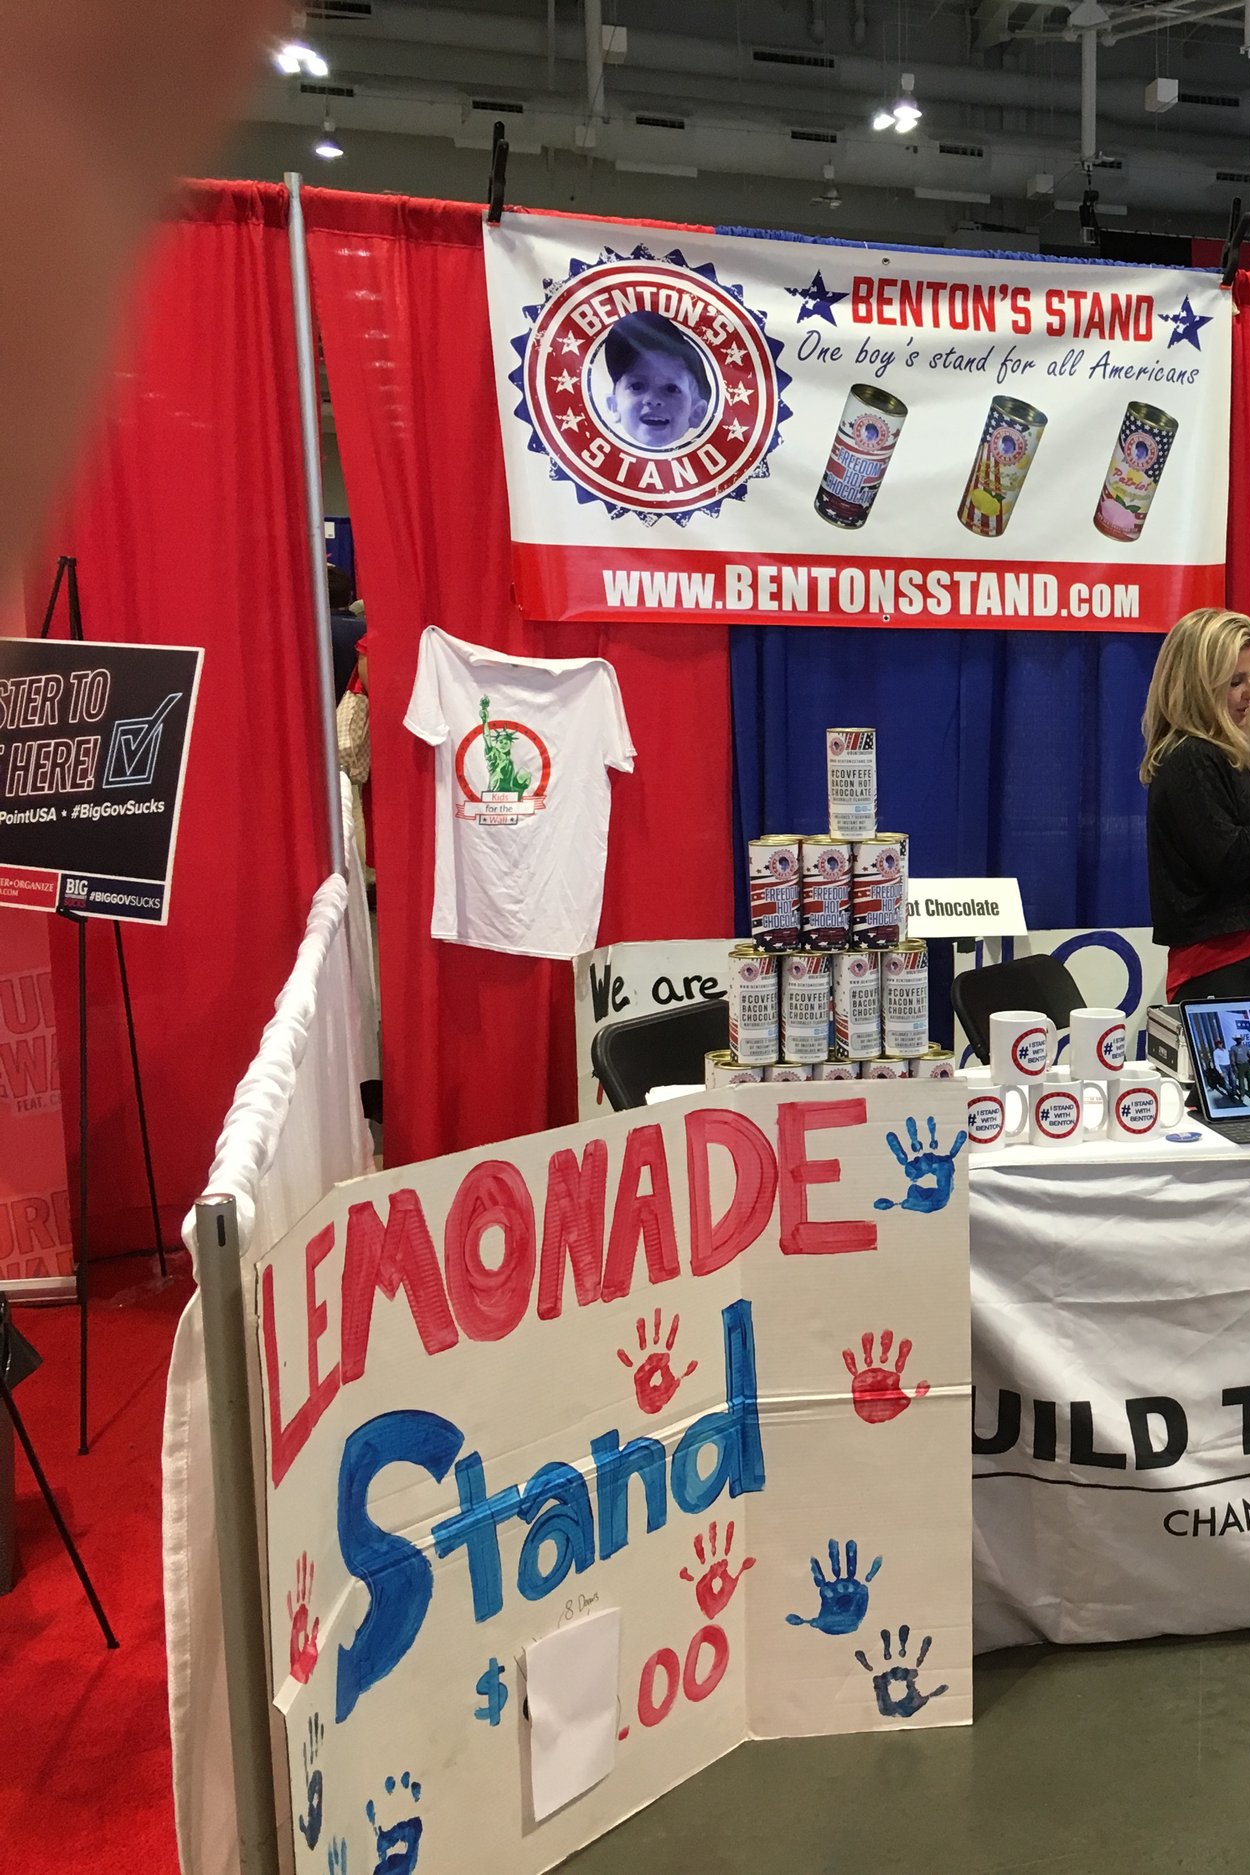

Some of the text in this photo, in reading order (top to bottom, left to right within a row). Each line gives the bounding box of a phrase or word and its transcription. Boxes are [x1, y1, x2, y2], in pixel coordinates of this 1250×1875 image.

[571, 286, 735, 345] BENTON'S
[851, 276, 1154, 341] BENTON'S STAND
[797, 331, 1199, 385] One boy's stand for all Americans
[582, 439, 727, 489] STAND
[844, 470, 865, 488] HOT
[603, 564, 1139, 618] WWW.BENTONSSTAND.COM
[69, 669, 111, 723] TO
[5, 736, 101, 797] HERE!
[831, 769, 872, 779] #COVFEFE
[831, 779, 872, 788] BACON HOT
[492, 793, 508, 801] Kids
[831, 788, 872, 797] CHOCOLATE
[71, 799, 165, 821] #BigGovSucks
[485, 804, 513, 812] for the
[65, 879, 88, 895] BIG
[89, 891, 161, 909] #BIGGOVSUCKS
[907, 898, 1000, 917] ot Chocolate
[590, 964, 728, 1023] We are
[1053, 1104, 1075, 1112] STAND
[1121, 1104, 1131, 1117] #
[1135, 1099, 1154, 1107] STAND
[1135, 1107, 1151, 1115] WITH
[980, 1108, 1000, 1116] STAND
[980, 1116, 997, 1124] WITH
[1040, 1109, 1050, 1121] #
[975, 1123, 1001, 1131] BENTON
[1049, 1119, 1075, 1127] BENTON
[262, 1097, 878, 1490] LEMONADE
[972, 1384, 1189, 1471] UILD
[334, 1299, 766, 1724] Stand
